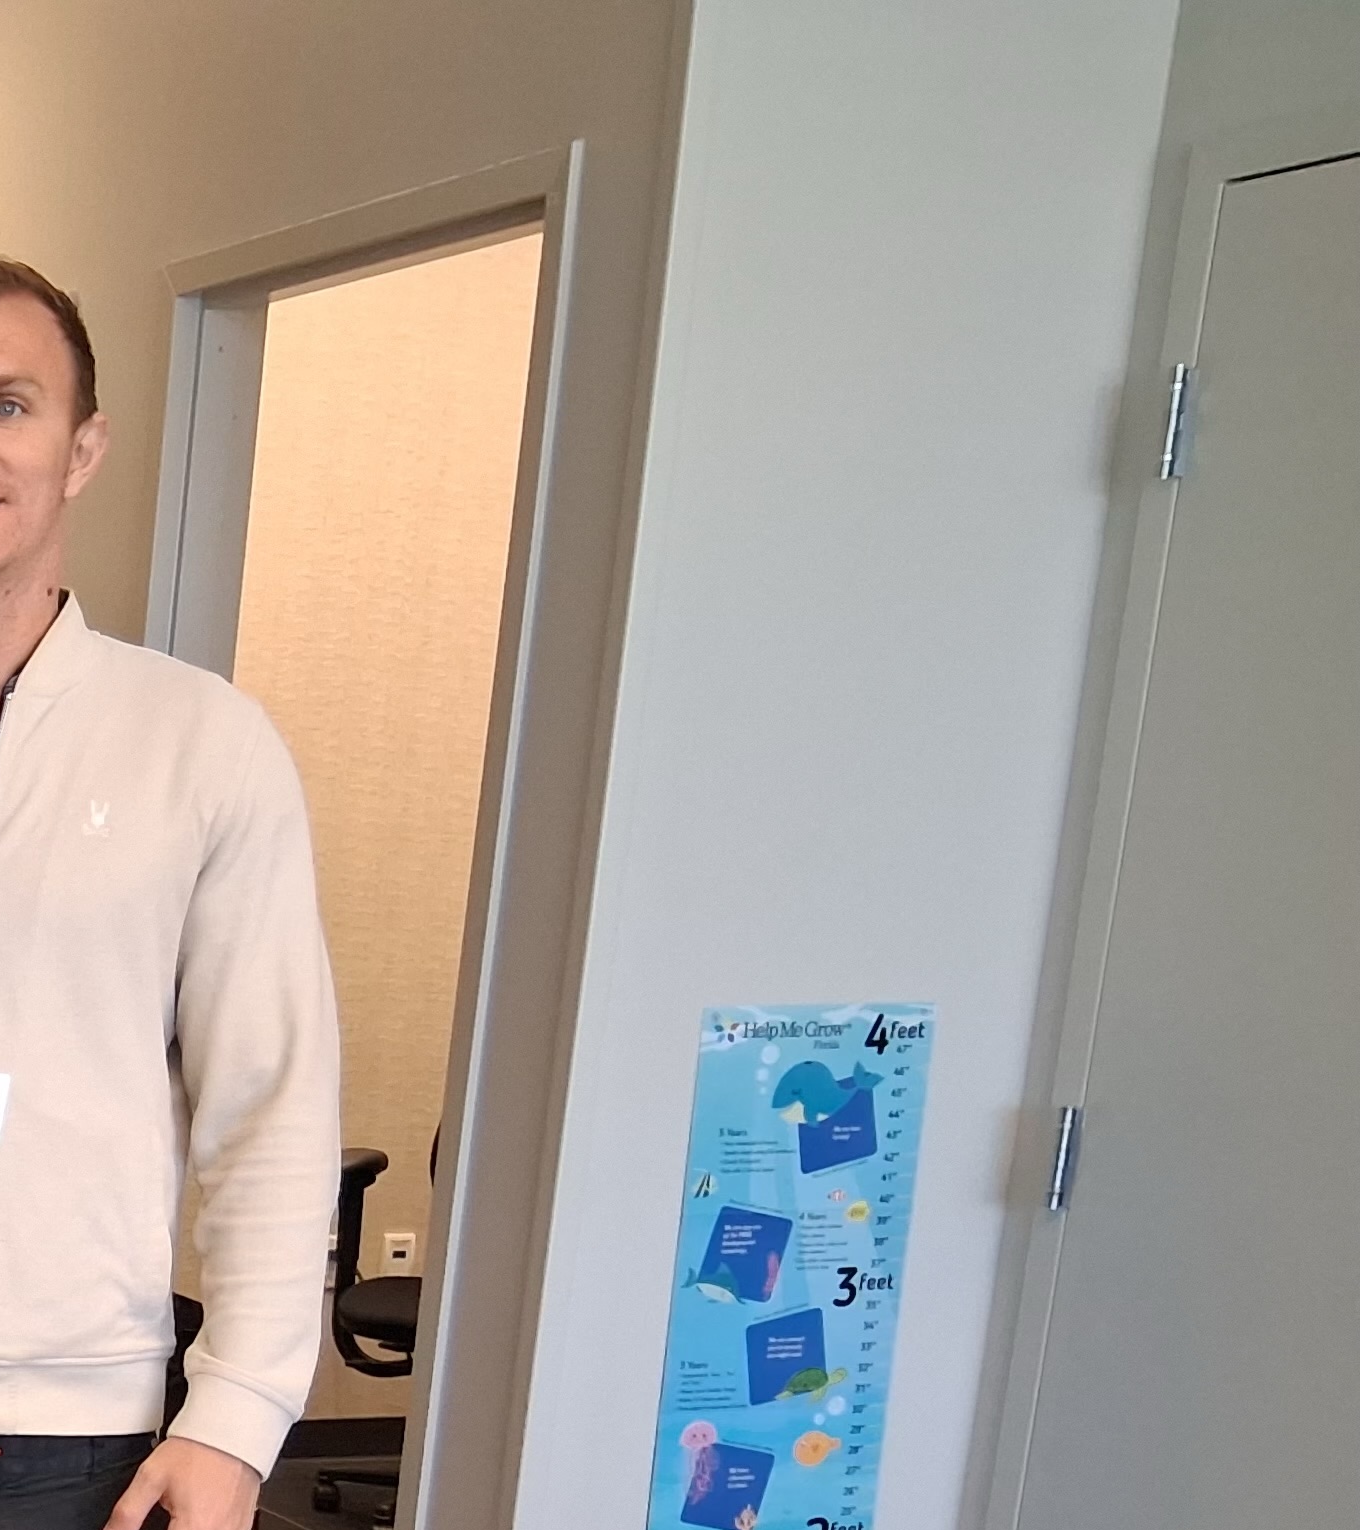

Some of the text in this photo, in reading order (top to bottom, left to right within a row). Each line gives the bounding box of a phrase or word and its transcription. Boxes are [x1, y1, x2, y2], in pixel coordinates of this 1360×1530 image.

[743, 1022, 779, 1040] Help
[780, 1022, 804, 1038] Me
[864, 1013, 926, 1055] 4 feet
[832, 1267, 895, 1307] 3 feet
